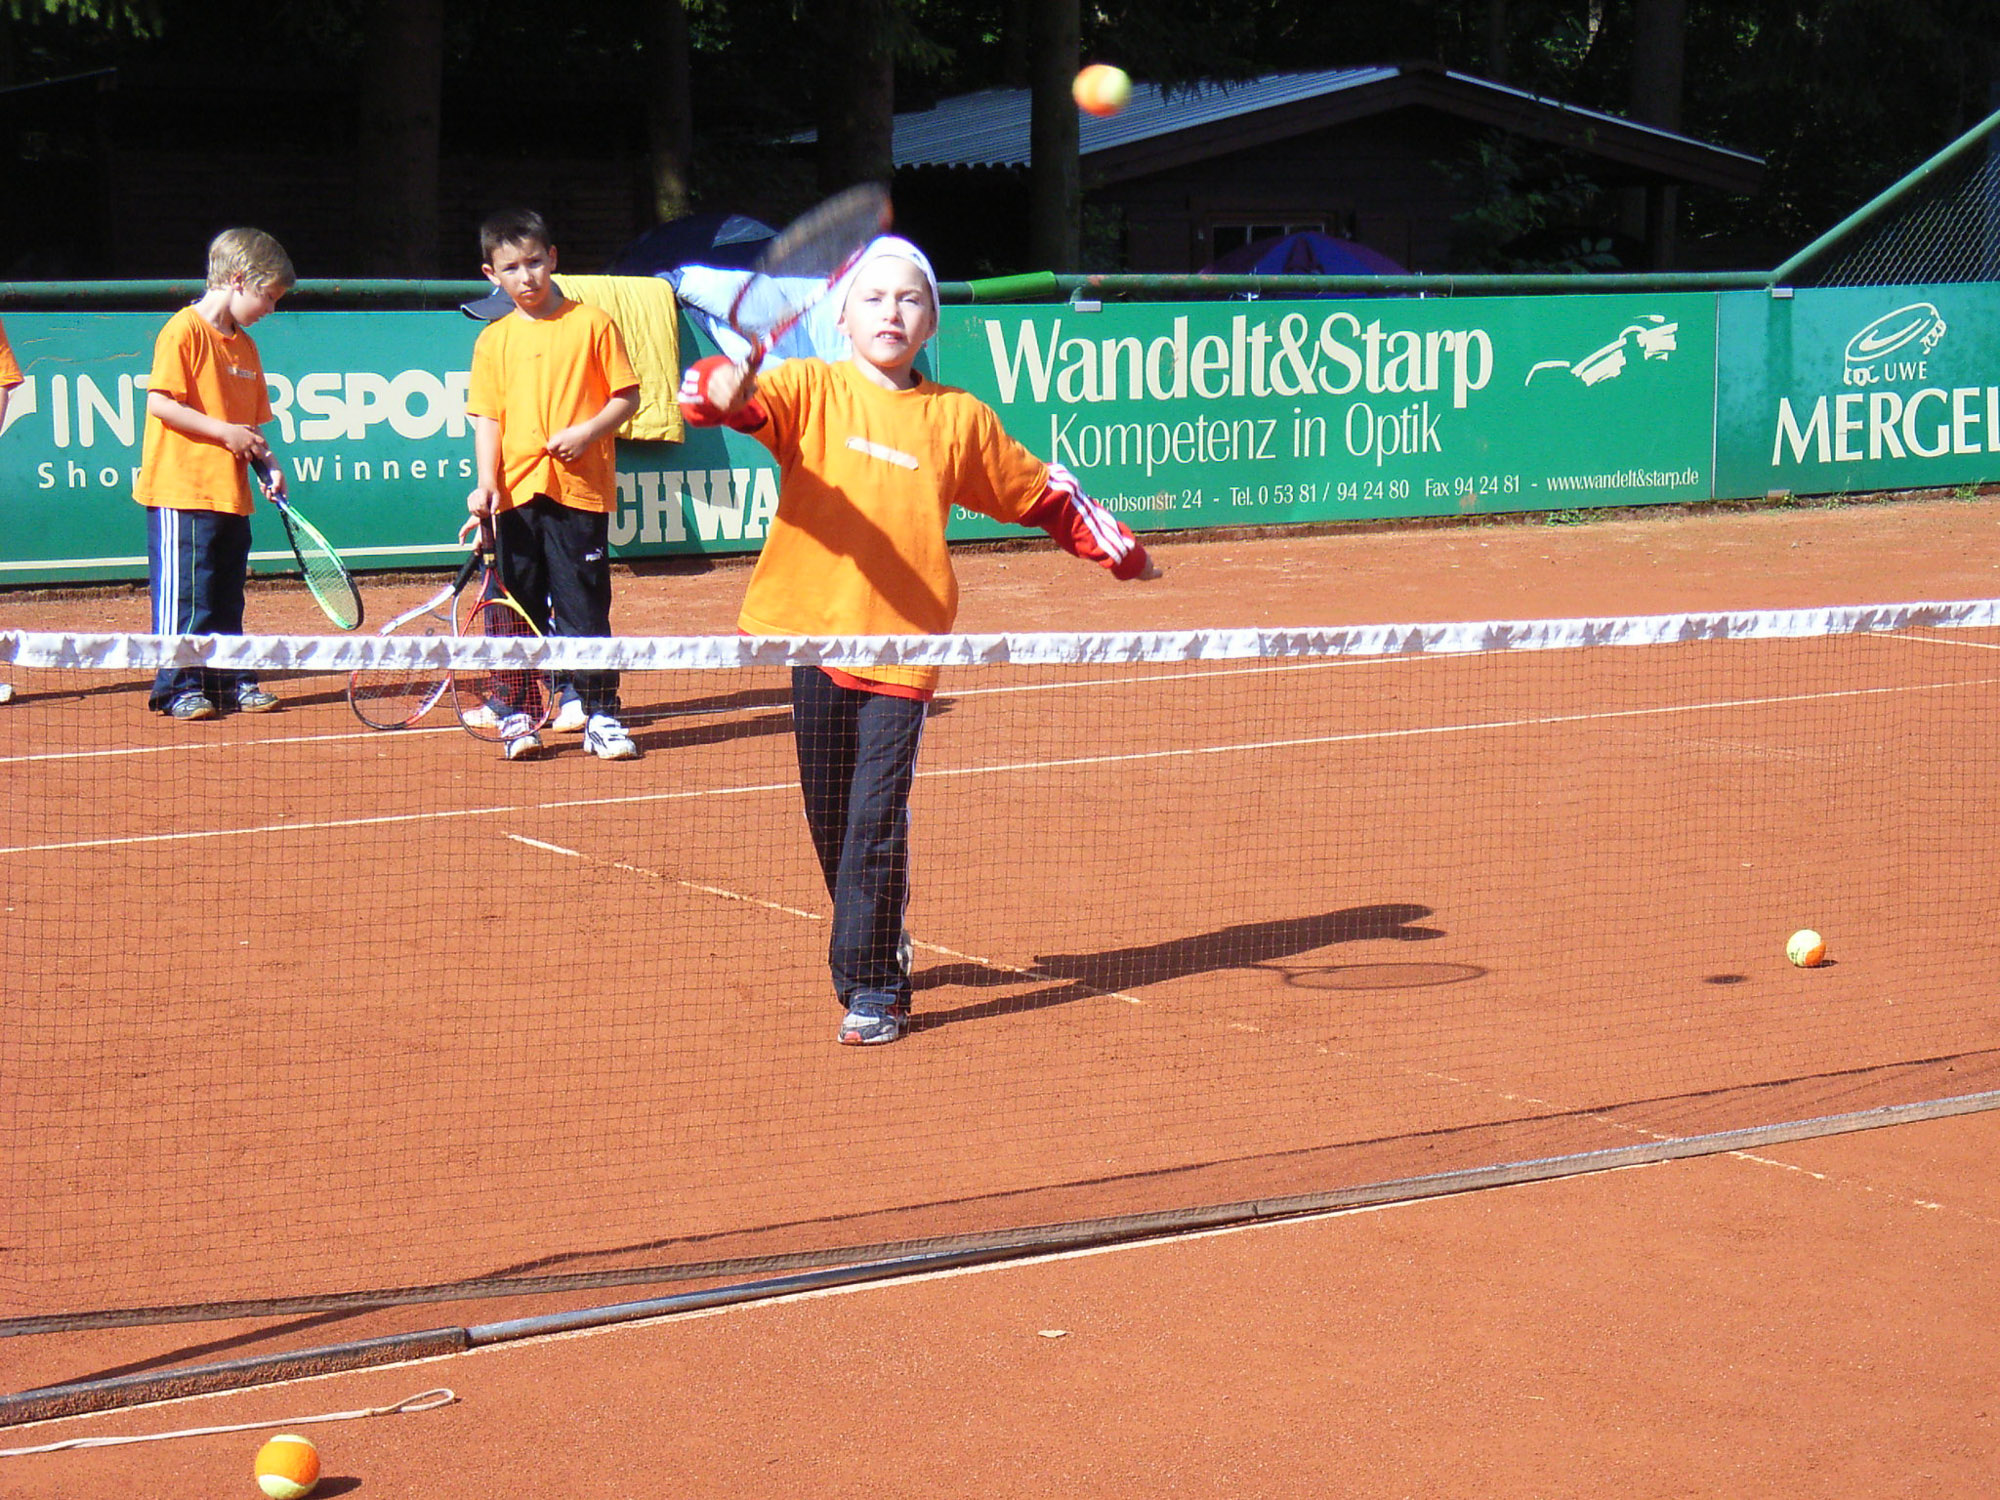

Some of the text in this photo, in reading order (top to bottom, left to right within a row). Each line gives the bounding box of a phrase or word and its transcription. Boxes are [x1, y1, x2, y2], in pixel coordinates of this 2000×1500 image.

[985, 312, 1494, 408] Wandelt&Starp
[1884, 361, 1928, 382] UWE
[293, 455, 472, 482] Winners
[1051, 401, 1443, 477] Kompetenz in Optik
[607, 467, 780, 547] CHWA
[1088, 491, 1177, 513] cobsonstr.
[1181, 488, 1203, 509] 24
[1229, 486, 1254, 506] Tel.
[1258, 485, 1269, 505] 0
[1273, 484, 1294, 504] 53
[1299, 483, 1317, 503] 81
[1336, 481, 1358, 502] 94
[1363, 480, 1384, 501] 24
[1388, 479, 1410, 500] 80
[1425, 478, 1450, 498] Fax
[1454, 476, 1474, 496] 94
[1479, 475, 1499, 495] 24
[1503, 474, 1521, 493] 81
[1546, 467, 1699, 491] www.wandelt&starp.de
